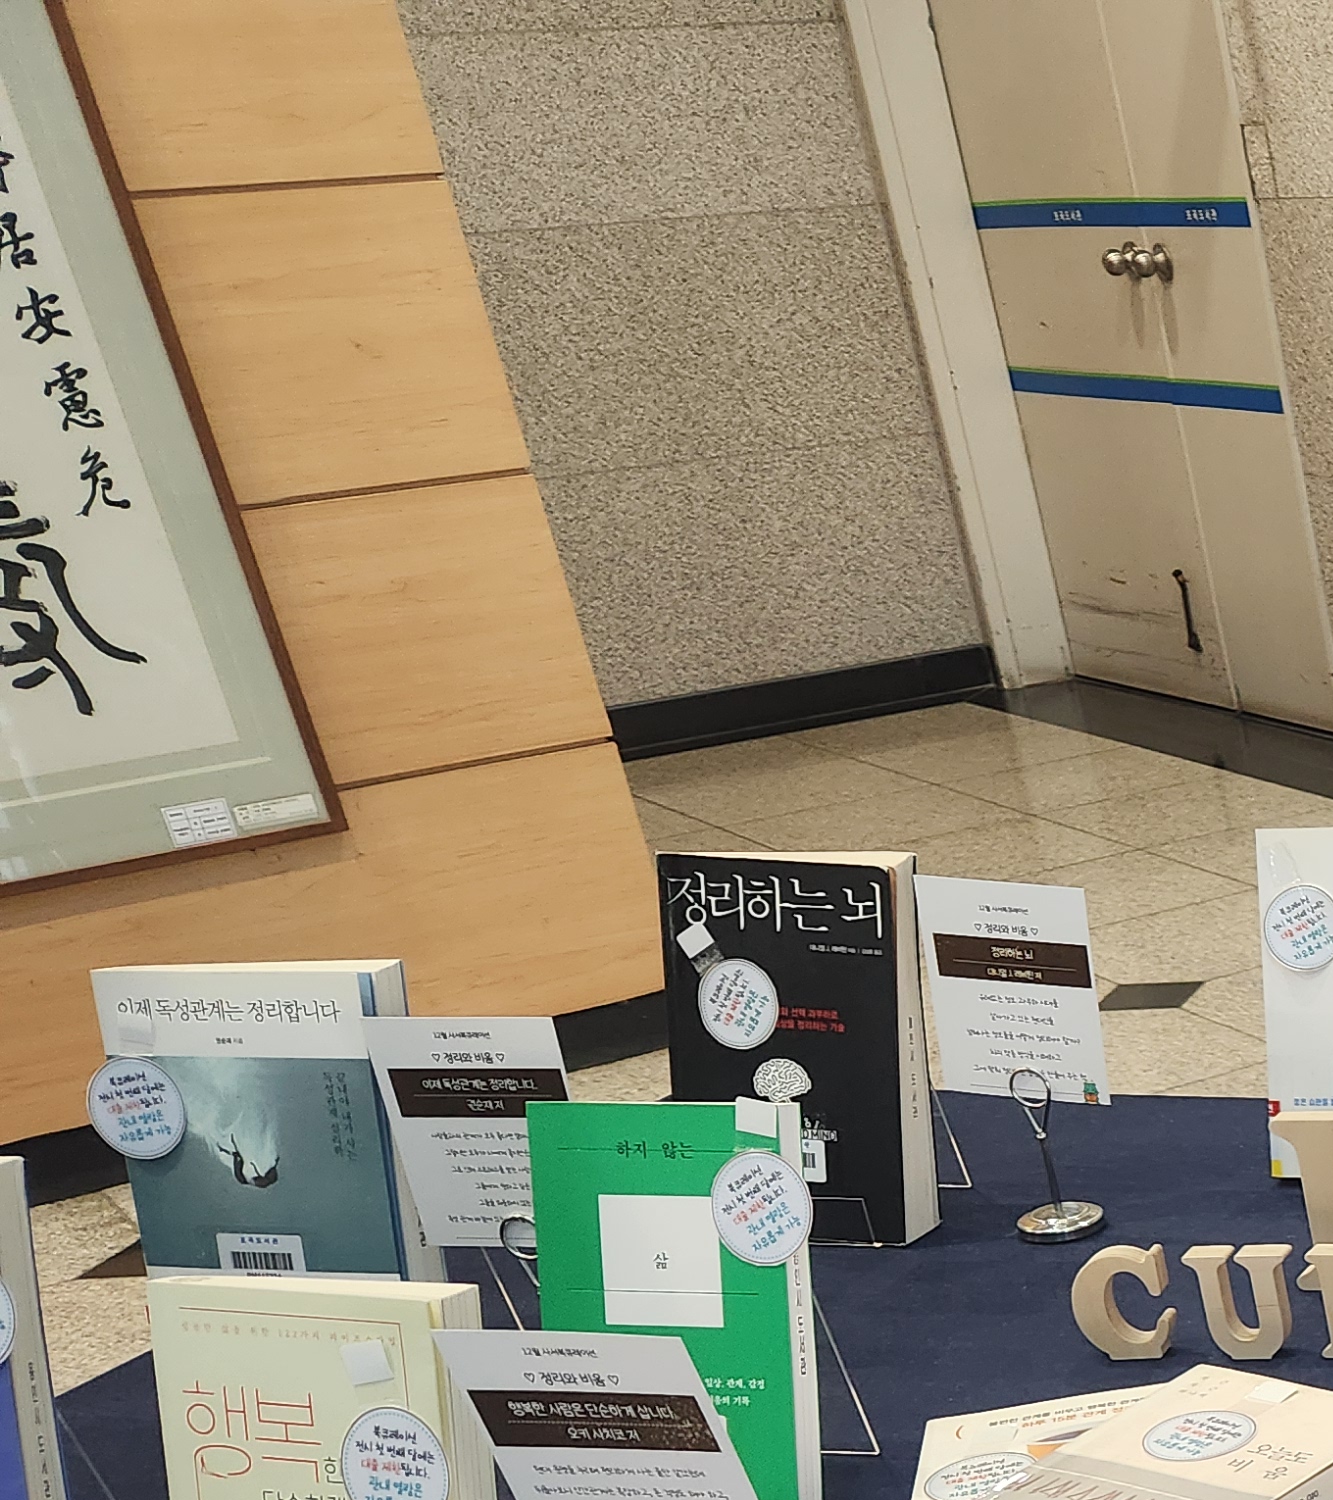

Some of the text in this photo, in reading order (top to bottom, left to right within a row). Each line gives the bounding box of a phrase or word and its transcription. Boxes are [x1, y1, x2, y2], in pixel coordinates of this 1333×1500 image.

[667, 871, 883, 938] 정리하는 뇌
[117, 999, 340, 1024] 이제 독성관계는 정리합니다
[616, 1139, 694, 1160] 하지 않는
[653, 1251, 669, 1269] 삶
[539, 1371, 605, 1388] 정리와 비움
[182, 1377, 321, 1482] 행복
